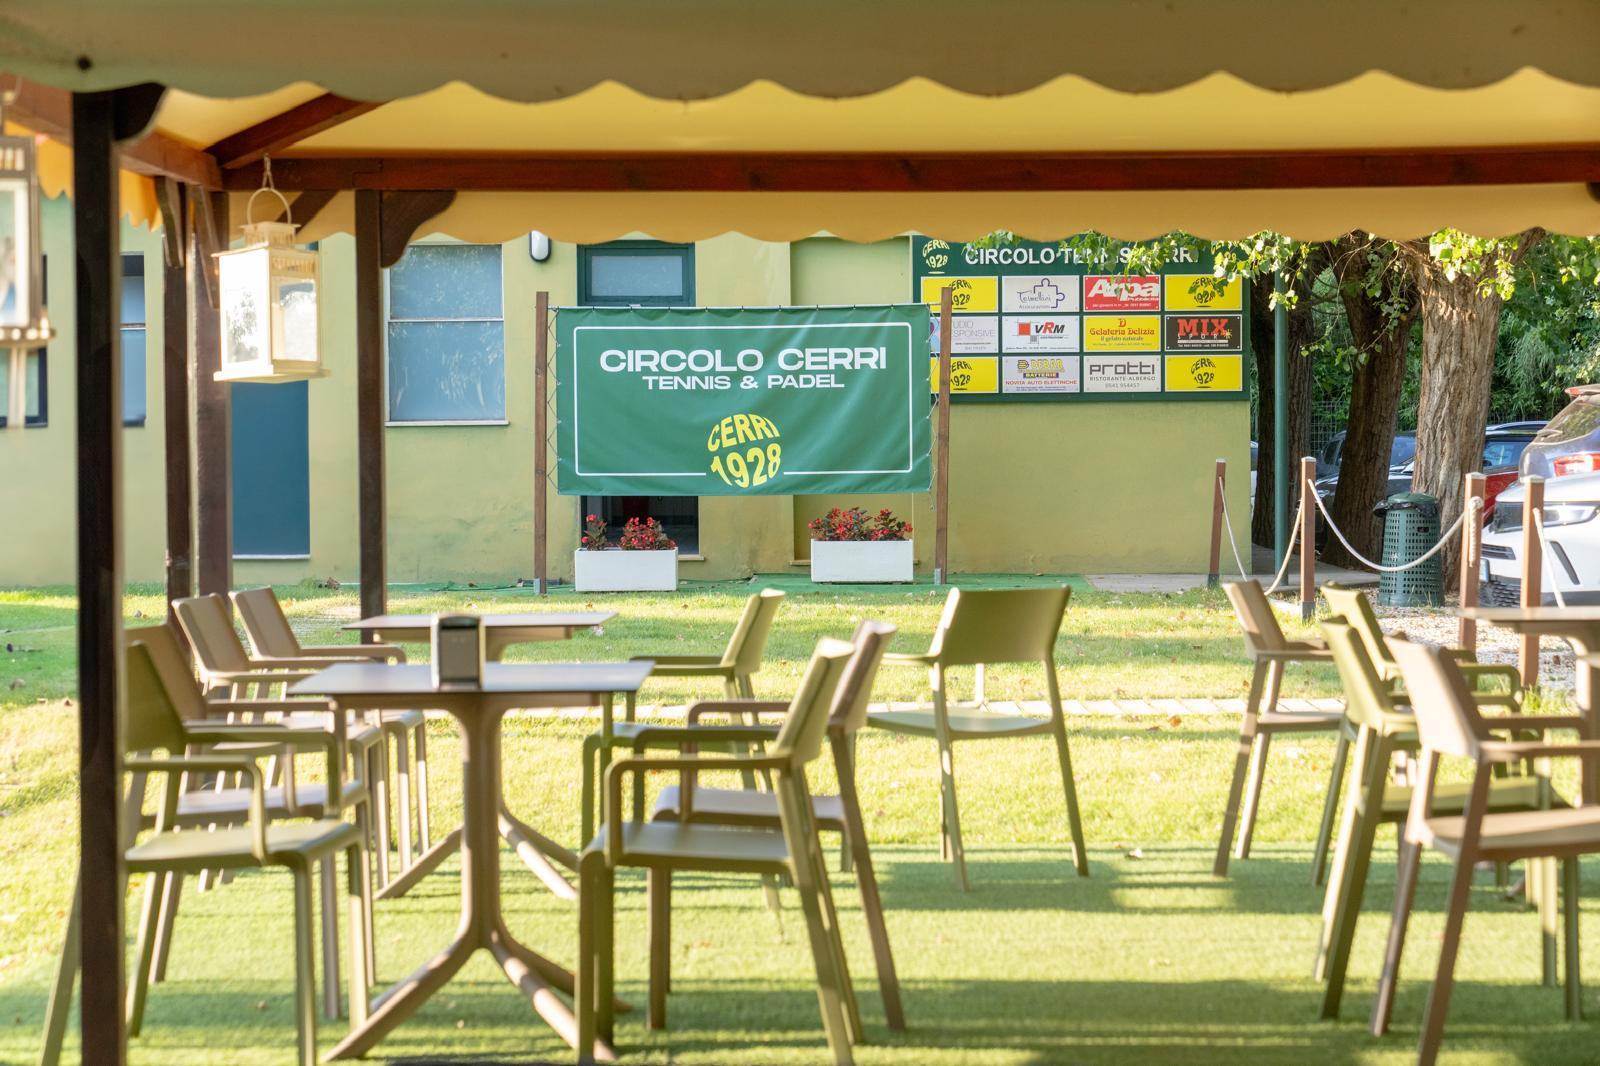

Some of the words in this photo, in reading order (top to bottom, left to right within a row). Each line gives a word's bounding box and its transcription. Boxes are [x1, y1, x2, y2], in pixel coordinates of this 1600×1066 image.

[926, 254, 948, 268] 1928
[965, 248, 1055, 264] CIRCOLO
[951, 279, 972, 291] ERRI
[1035, 322, 1065, 334] VRM
[1089, 328, 1125, 336] Gelateria
[1128, 328, 1155, 336] Delizia
[1177, 319, 1228, 336] MIX
[600, 349, 764, 373] CIRCOLO
[778, 346, 887, 371] CERRI
[951, 360, 972, 372] ERRI
[1191, 358, 1216, 374] CERRI
[1090, 361, 1155, 375] protti
[642, 375, 731, 390] TENNIS
[739, 375, 759, 389] &
[767, 373, 845, 389] PADEL
[1194, 371, 1215, 384] 1928
[707, 413, 781, 452] CERRI
[710, 443, 782, 488] 1928
